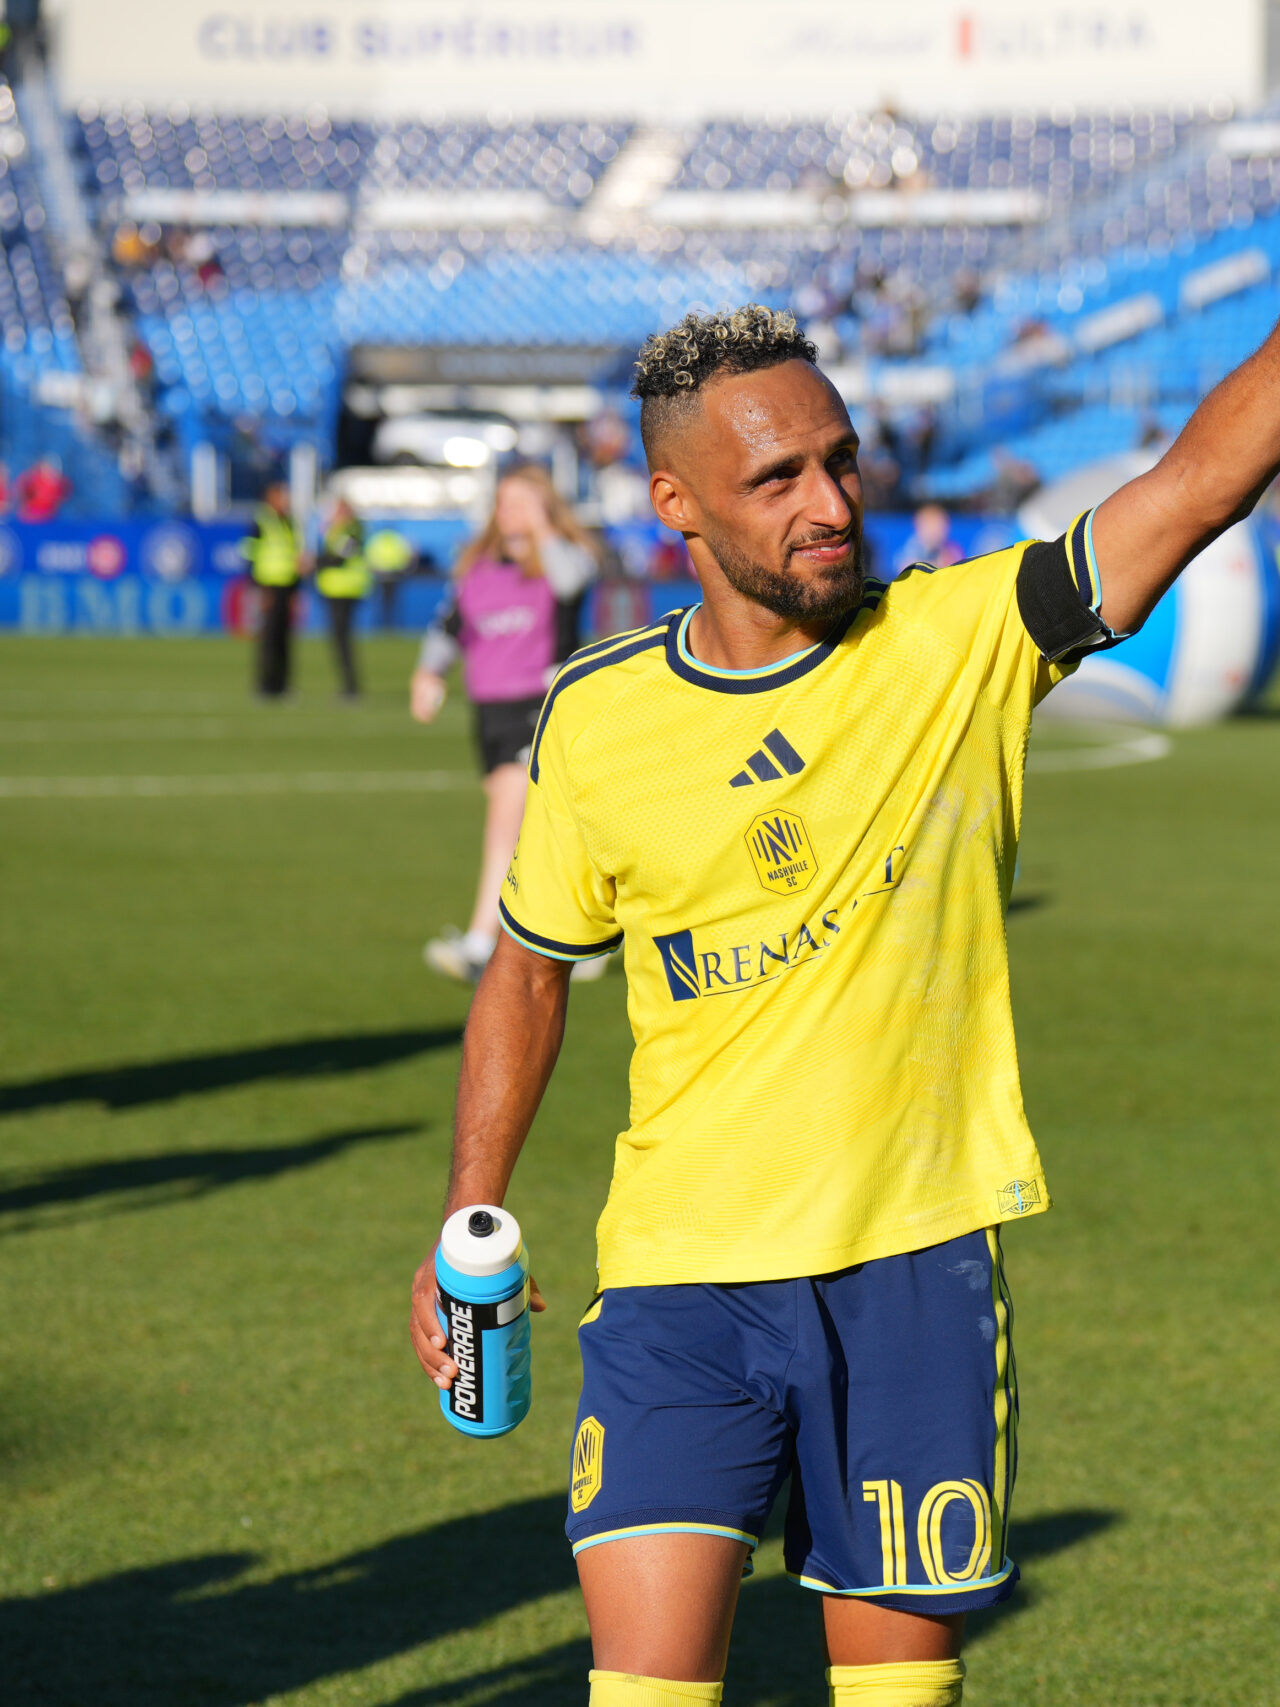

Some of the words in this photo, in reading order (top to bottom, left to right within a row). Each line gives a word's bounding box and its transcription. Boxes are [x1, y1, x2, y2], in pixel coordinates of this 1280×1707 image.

[198, 13, 334, 60] CLUB
[767, 860, 808, 881] NASHVILLE
[786, 876, 798, 888] SC
[450, 1302, 477, 1419] POWERADE
[862, 1478, 992, 1587] 10
